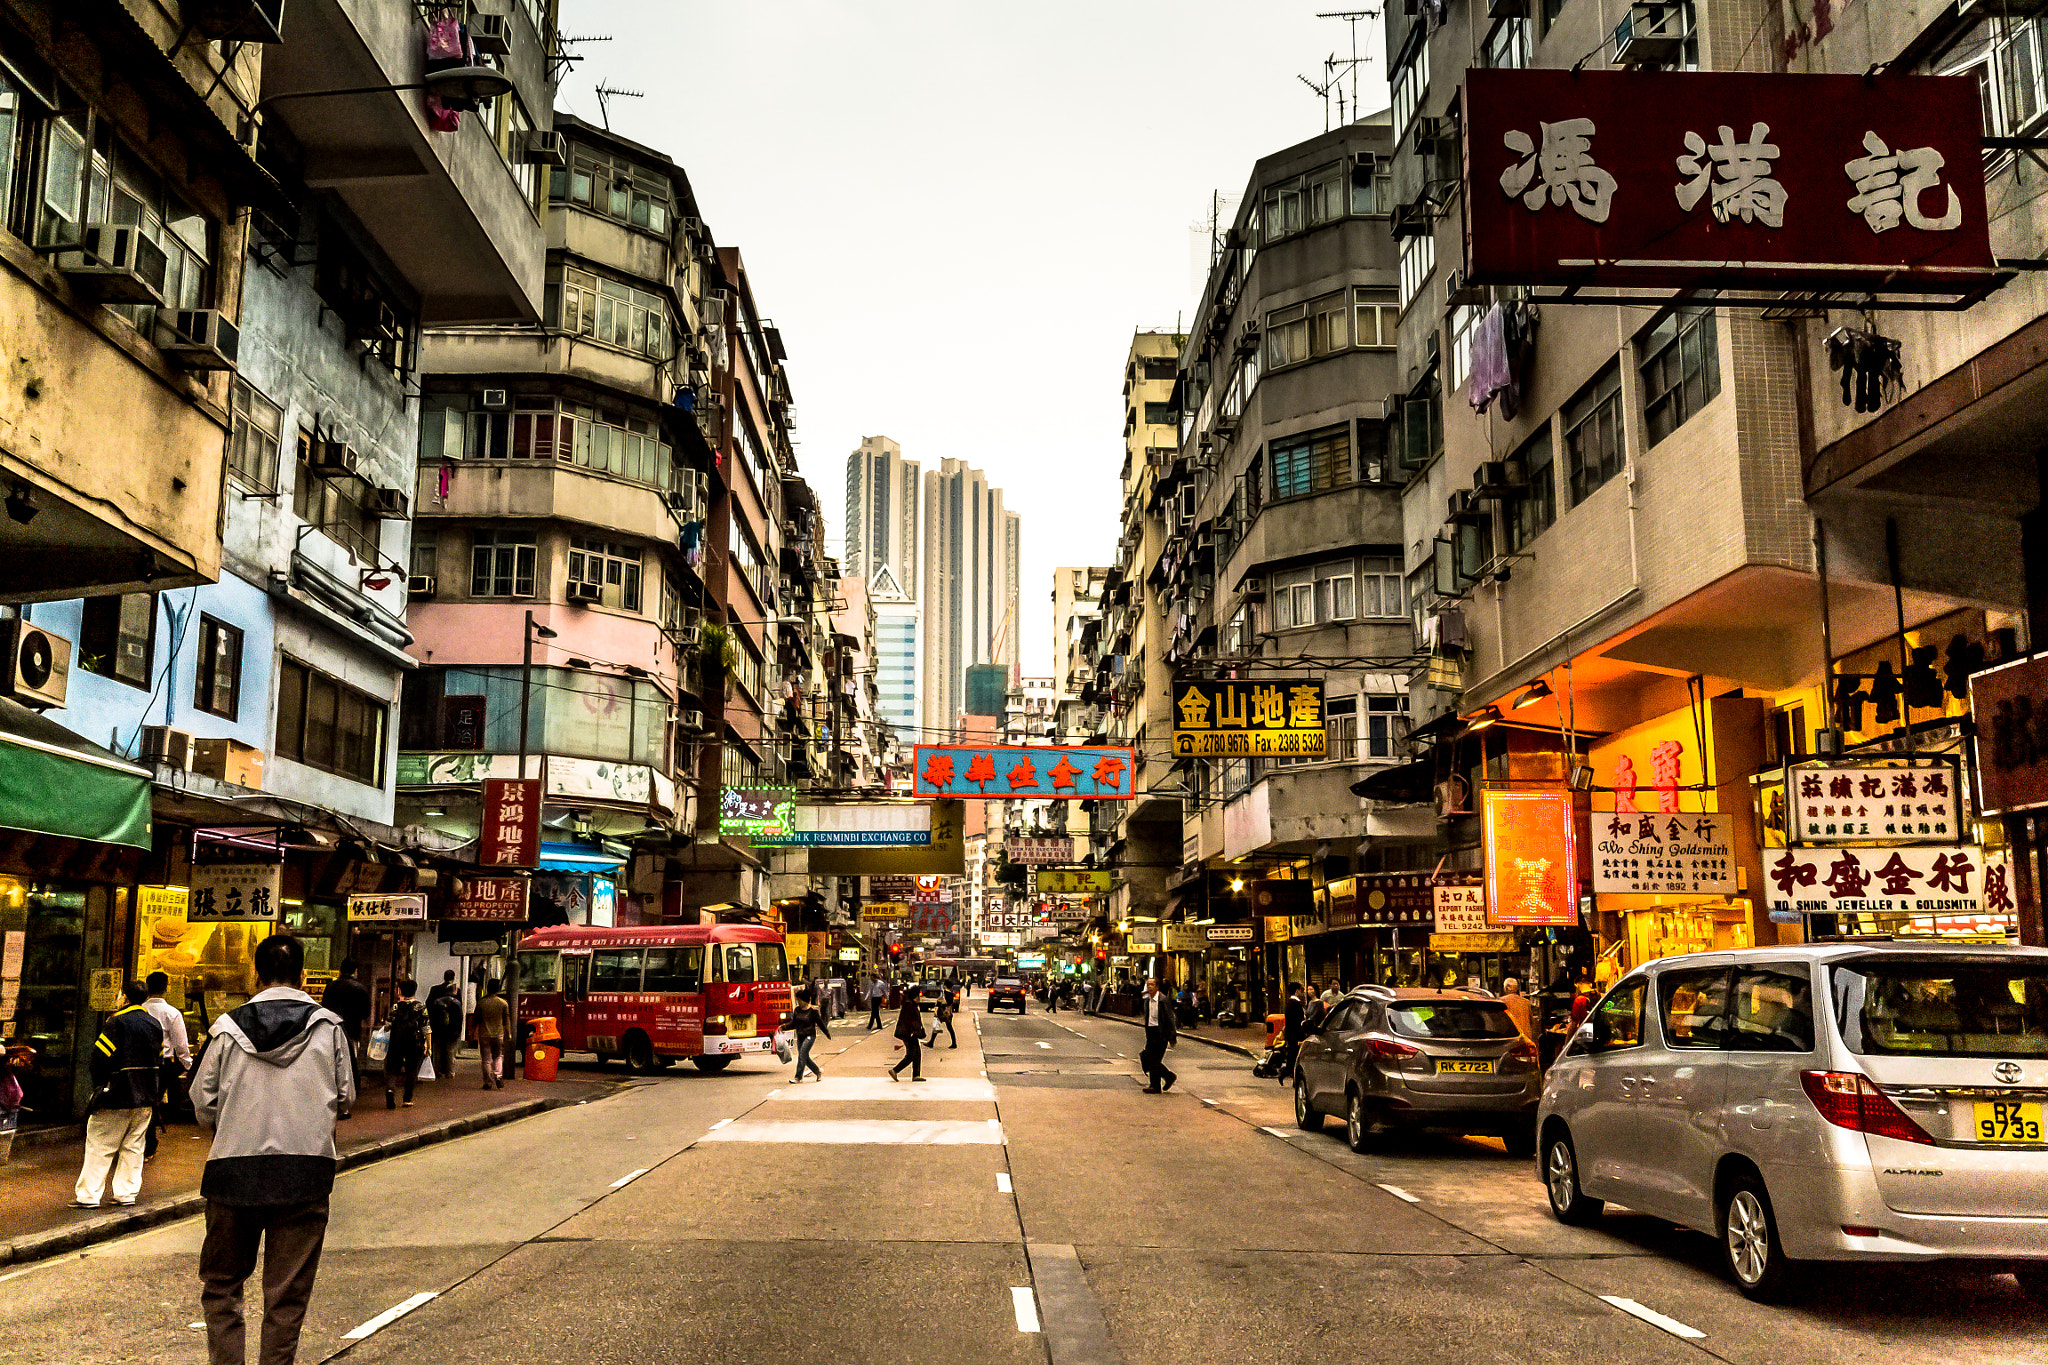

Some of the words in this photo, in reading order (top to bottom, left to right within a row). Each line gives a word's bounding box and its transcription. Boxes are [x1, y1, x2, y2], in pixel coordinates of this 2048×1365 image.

[1499, 118, 1962, 234] 馮滿記
[1177, 684, 1322, 729] 金山地產
[1228, 733, 1249, 752] 9676
[1278, 733, 1300, 752] 2388
[1302, 733, 1324, 752] 5328
[495, 781, 526, 865] 景鴻地產
[723, 819, 744, 827] FOOT
[745, 819, 781, 827] MASSAGE
[1607, 814, 1717, 843] 和盛金行
[813, 833, 860, 842] RENMINBI
[861, 832, 912, 842] EXCHANGE
[1598, 840, 1624, 854] Wo
[1628, 840, 1664, 859] Shing
[1668, 843, 1728, 857] Goldsmith
[1770, 849, 1976, 899] 和盛金行
[1665, 882, 1687, 891] 1892
[194, 886, 274, 917] 張立龍
[991, 900, 1001, 910] 大
[1440, 889, 1482, 904] 出口成
[1773, 900, 1789, 911] WO
[1796, 900, 1828, 911] SHING
[1835, 900, 1893, 911] JEWELLER
[1900, 900, 1909, 910] &
[1916, 899, 1977, 910] GOLDSMITH
[481, 909, 515, 918] 7522
[1441, 1062, 1455, 1072] RK
[1459, 1062, 1489, 1072] 2722
[1981, 1120, 2039, 1139] 9733
[1883, 1168, 1944, 1177] ALPHARD
